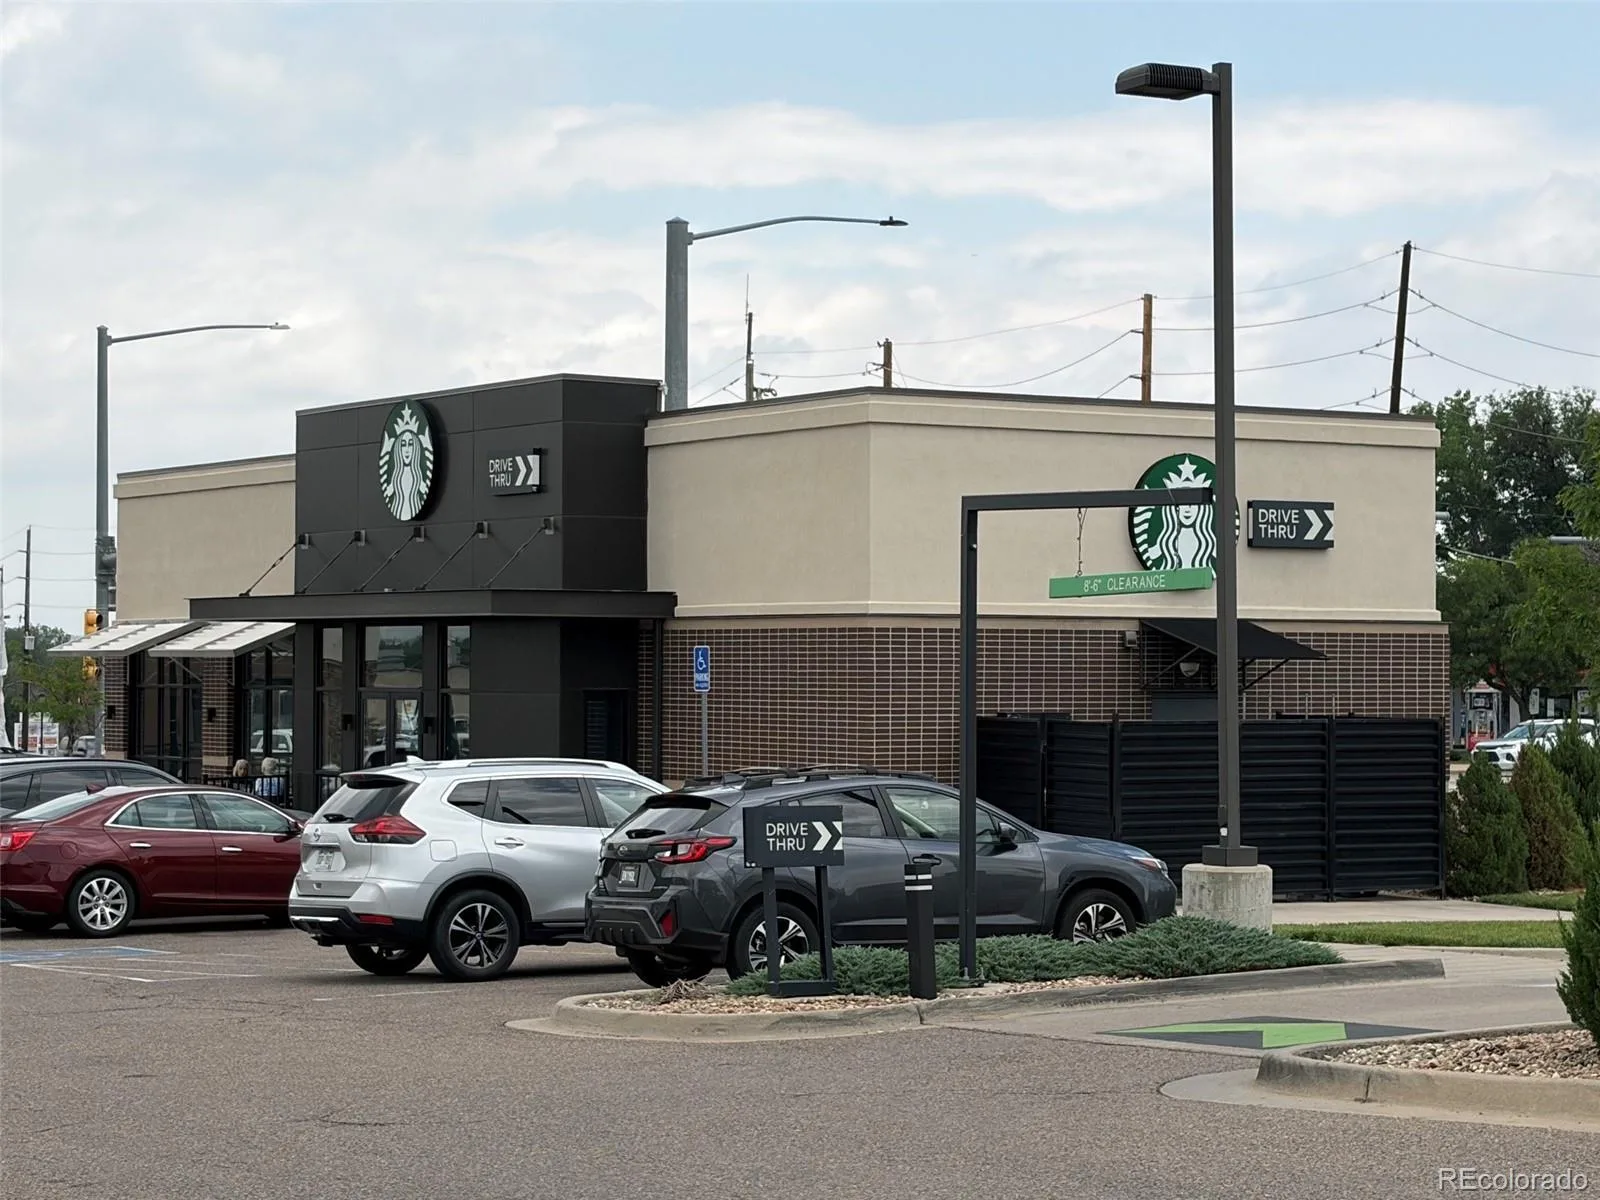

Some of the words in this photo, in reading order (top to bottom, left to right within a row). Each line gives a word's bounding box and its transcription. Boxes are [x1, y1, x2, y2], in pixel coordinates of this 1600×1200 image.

[489, 458, 513, 473] DRIVE
[489, 473, 511, 488] THRU
[1258, 509, 1300, 524] DRIVE
[1258, 524, 1296, 539] THRU
[1107, 574, 1166, 591] CLEARANCE
[766, 822, 809, 836] DRIVE
[766, 837, 806, 851] THRU
